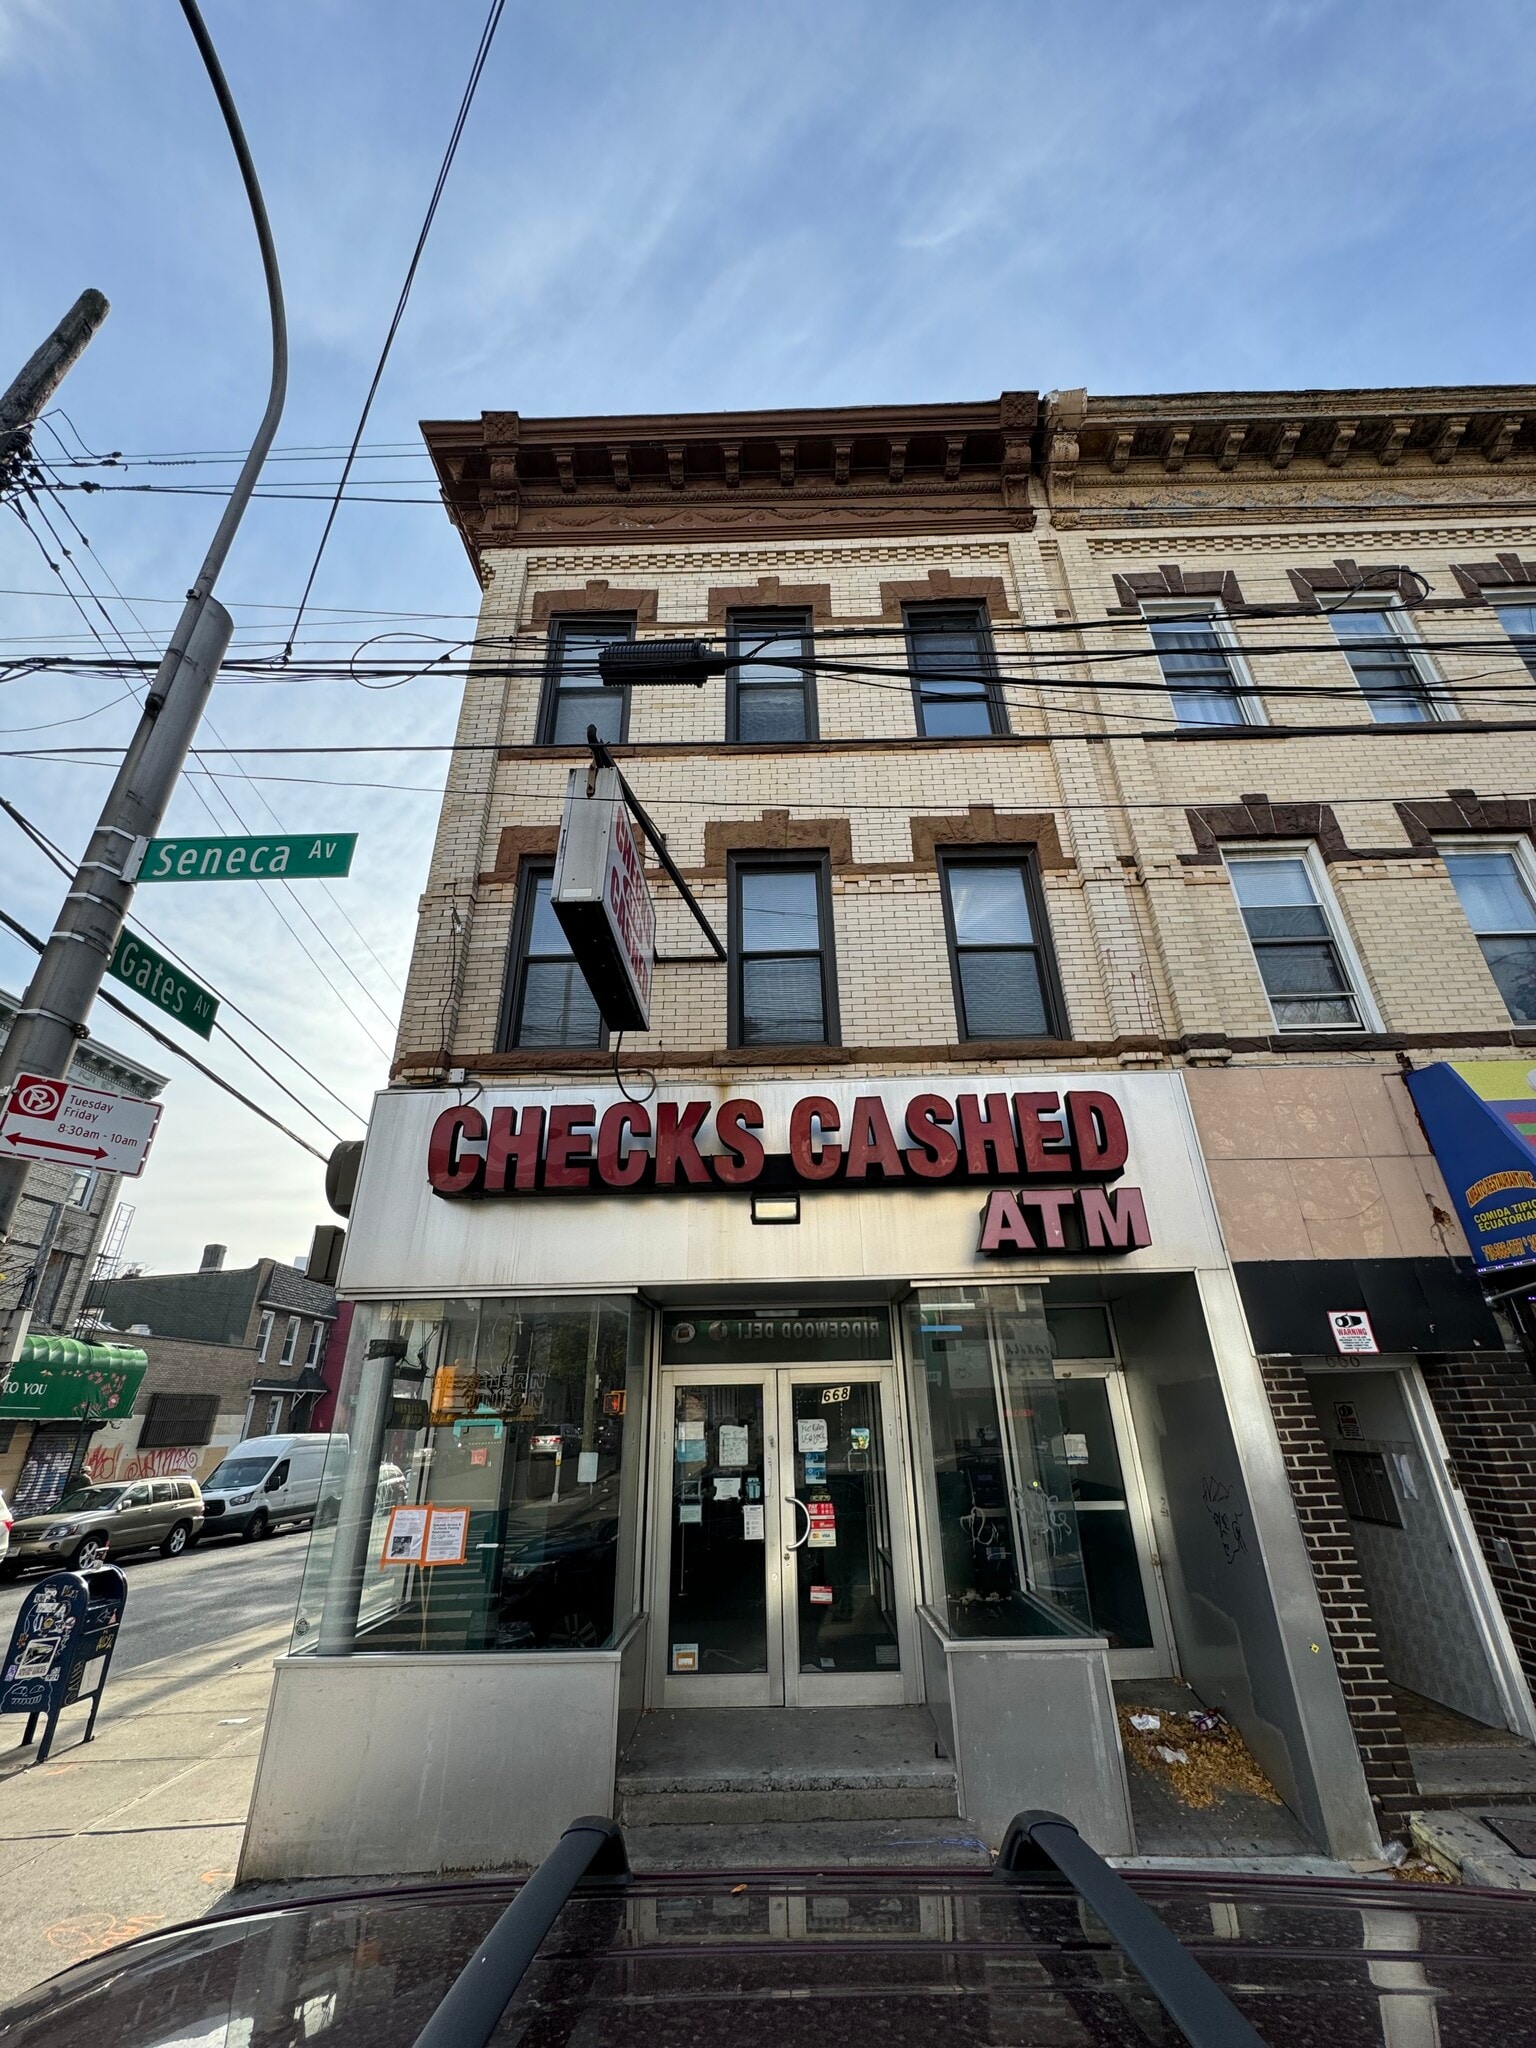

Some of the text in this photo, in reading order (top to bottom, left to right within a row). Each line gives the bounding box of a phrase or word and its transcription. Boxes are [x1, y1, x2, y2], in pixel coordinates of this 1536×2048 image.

[152, 839, 338, 876] Seneca Av
[615, 804, 651, 951] CHECKS
[609, 865, 648, 1006] CASHED
[120, 942, 210, 1018] Gates Av
[63, 1107, 99, 1123] Friday
[70, 1094, 114, 1113] Tuesday
[57, 1123, 100, 1140] 8:30am
[110, 1133, 138, 1147] 10am
[428, 1090, 1129, 1195] CHECKS CASHED
[980, 1188, 1151, 1254] ATM
[1474, 1206, 1510, 1223] COMIDA
[23, 1382, 48, 1395] YOU
[823, 1387, 849, 1402] 668
